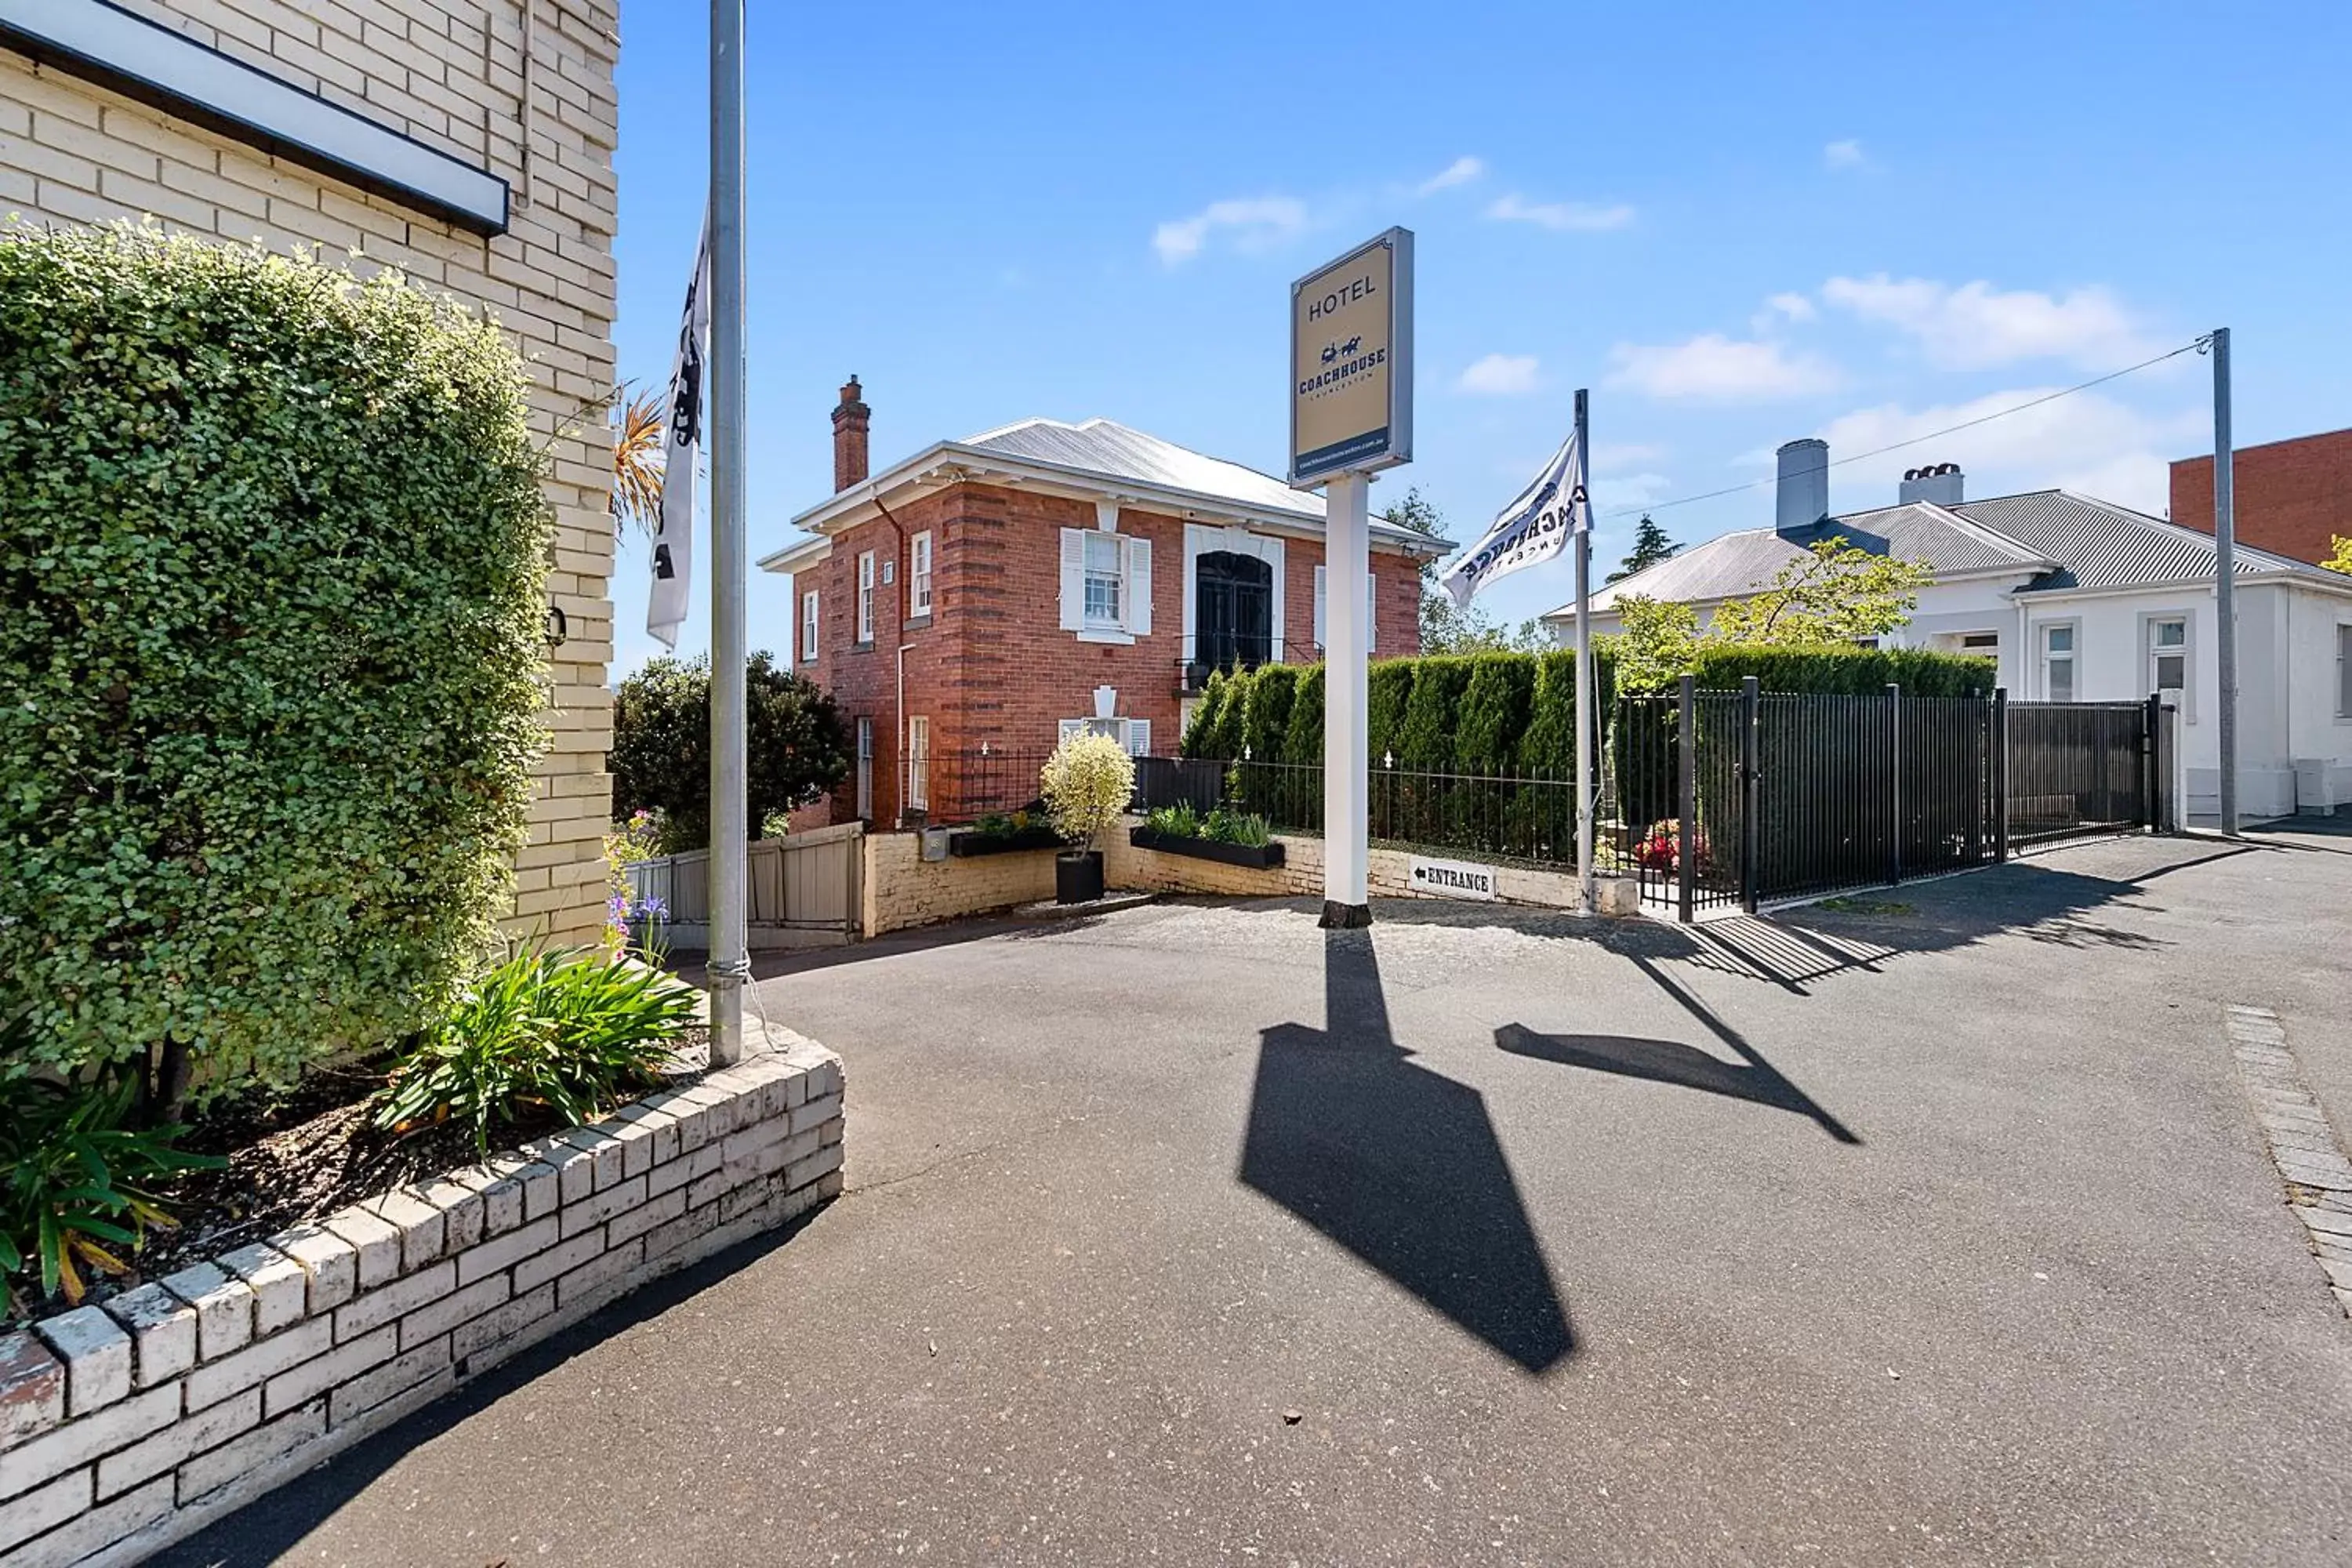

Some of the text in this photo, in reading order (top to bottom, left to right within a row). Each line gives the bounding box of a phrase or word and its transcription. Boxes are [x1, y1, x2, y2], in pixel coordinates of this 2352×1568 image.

[1309, 276, 1376, 322] HOTEL
[1299, 348, 1385, 394] COACHHOUSE
[1428, 866, 1489, 892] ENTRANCE
